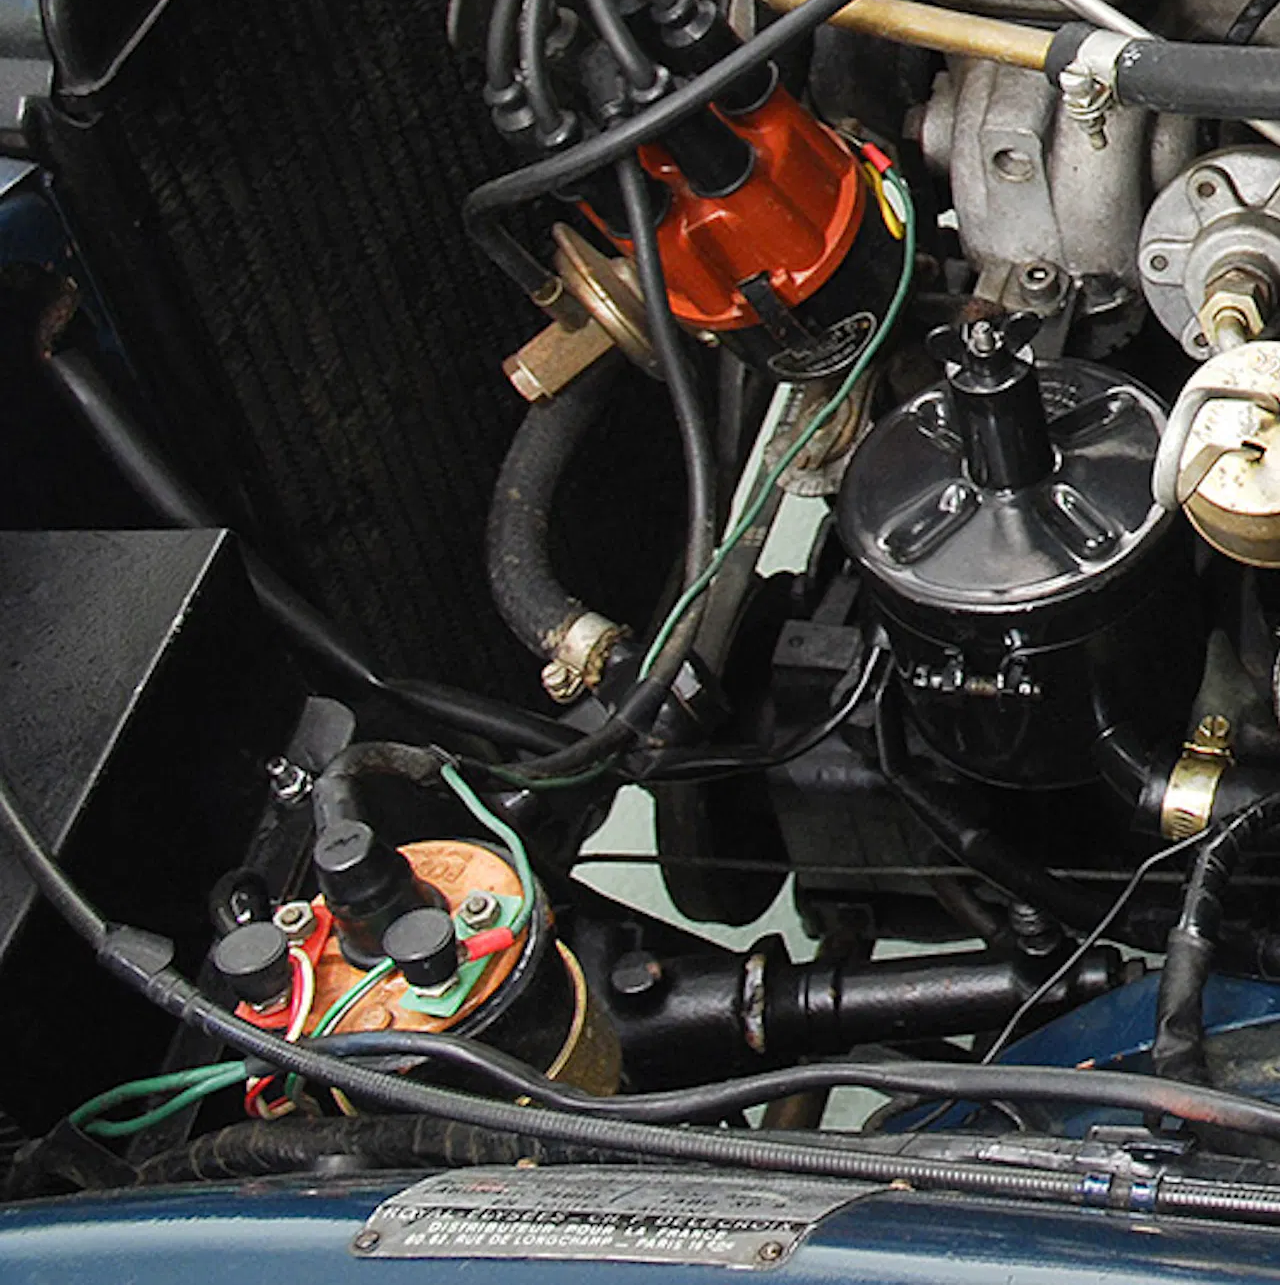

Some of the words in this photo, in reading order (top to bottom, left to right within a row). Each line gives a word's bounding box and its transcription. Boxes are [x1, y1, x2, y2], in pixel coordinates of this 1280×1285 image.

[427, 1221, 555, 1235] DISTRIBUTEUR
[564, 1223, 616, 1236] POUR
[625, 1226, 646, 1237] LA
[656, 1227, 729, 1241] FRANCE
[635, 1238, 683, 1251] PARIS
